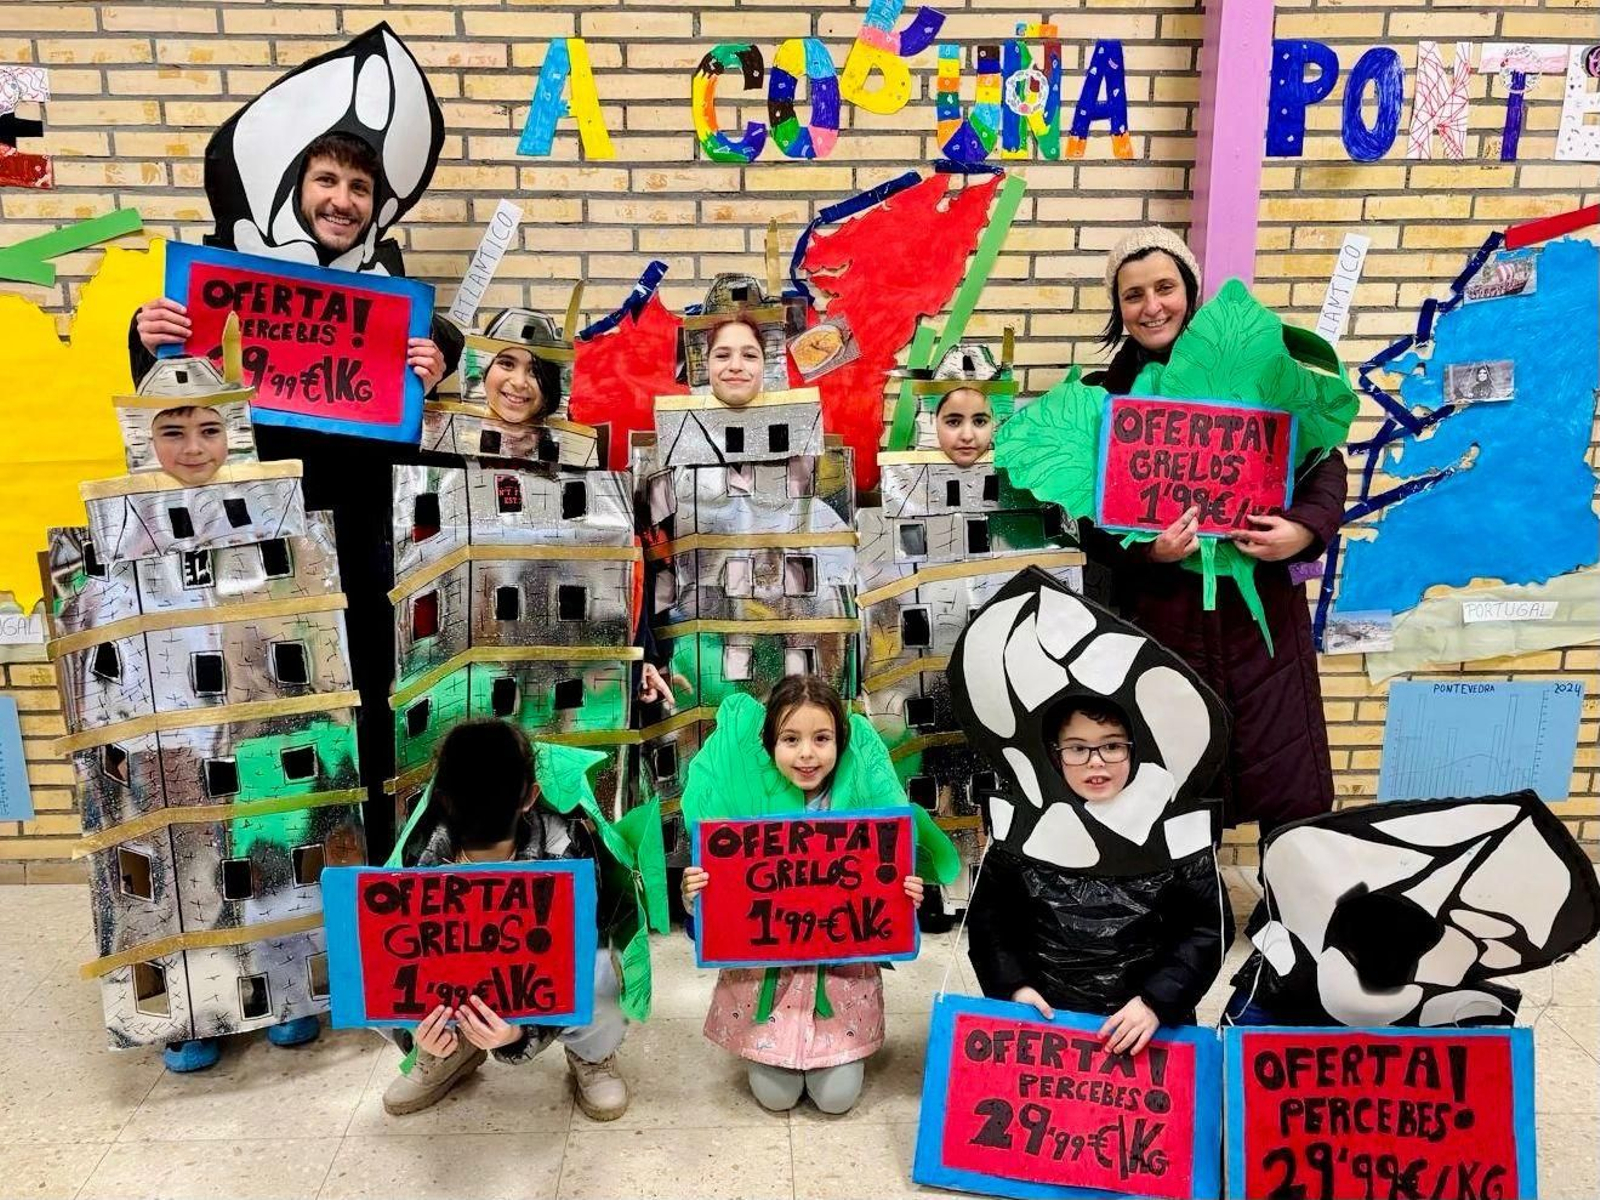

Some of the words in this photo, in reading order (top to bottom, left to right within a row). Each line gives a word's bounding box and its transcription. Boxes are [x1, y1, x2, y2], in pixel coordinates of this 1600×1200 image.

[516, 38, 616, 160] A
[692, 0, 1135, 163] CORUÑA
[1319, 244, 1361, 334] LANTICO
[202, 280, 374, 349] OFERTA!
[238, 319, 337, 346] ERCEBES
[1114, 407, 1278, 464] OFERTA!
[1129, 450, 1245, 485] GRELOS
[1464, 602, 1550, 618] PORTUGAL
[1433, 683, 1495, 694] PONTEVEDRA
[1554, 682, 1582, 697] 2024
[708, 821, 899, 885] OFERTA!
[745, 855, 863, 893] GRELOS
[364, 874, 555, 953] OFERTA!
[383, 914, 524, 959] GRELOS
[964, 1029, 1171, 1114] OFERTA!
[1019, 1074, 1142, 1112] PERCEBES
[1254, 1044, 1475, 1129] OFERTA!
[1279, 1097, 1451, 1142] PERCEBES
